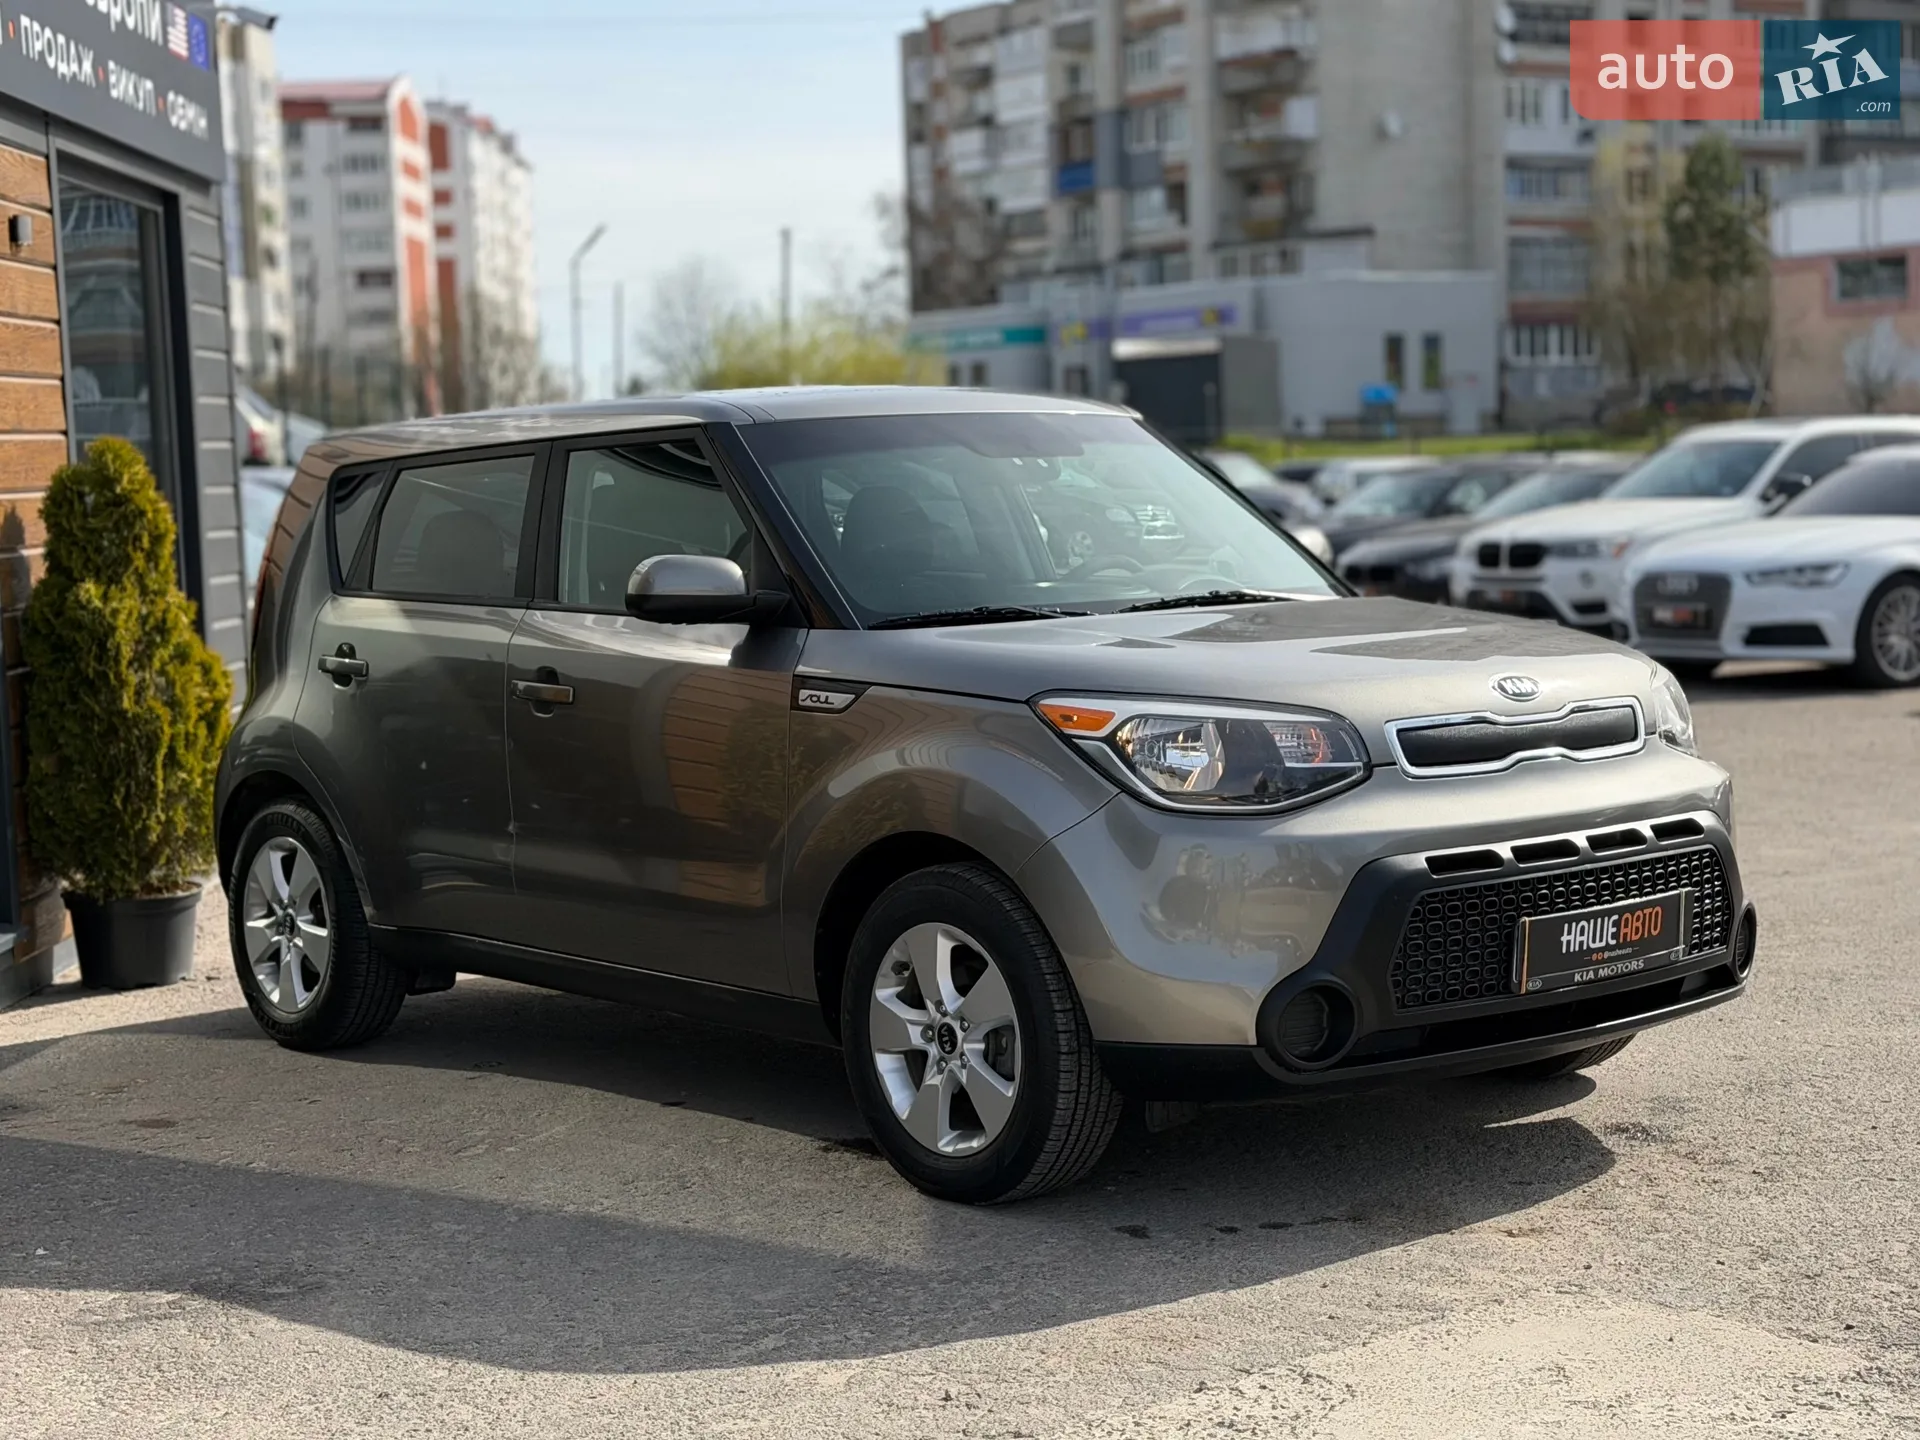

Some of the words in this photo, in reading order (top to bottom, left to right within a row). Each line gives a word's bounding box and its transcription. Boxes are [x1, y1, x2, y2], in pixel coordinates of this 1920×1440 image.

[20, 13, 96, 88] ПРОДАЖ
[108, 59, 157, 117] ВИКУП
[1574, 969, 1595, 983] KIA
[1597, 959, 1645, 979] MOTORS
[940, 1025, 952, 1052] KIA
